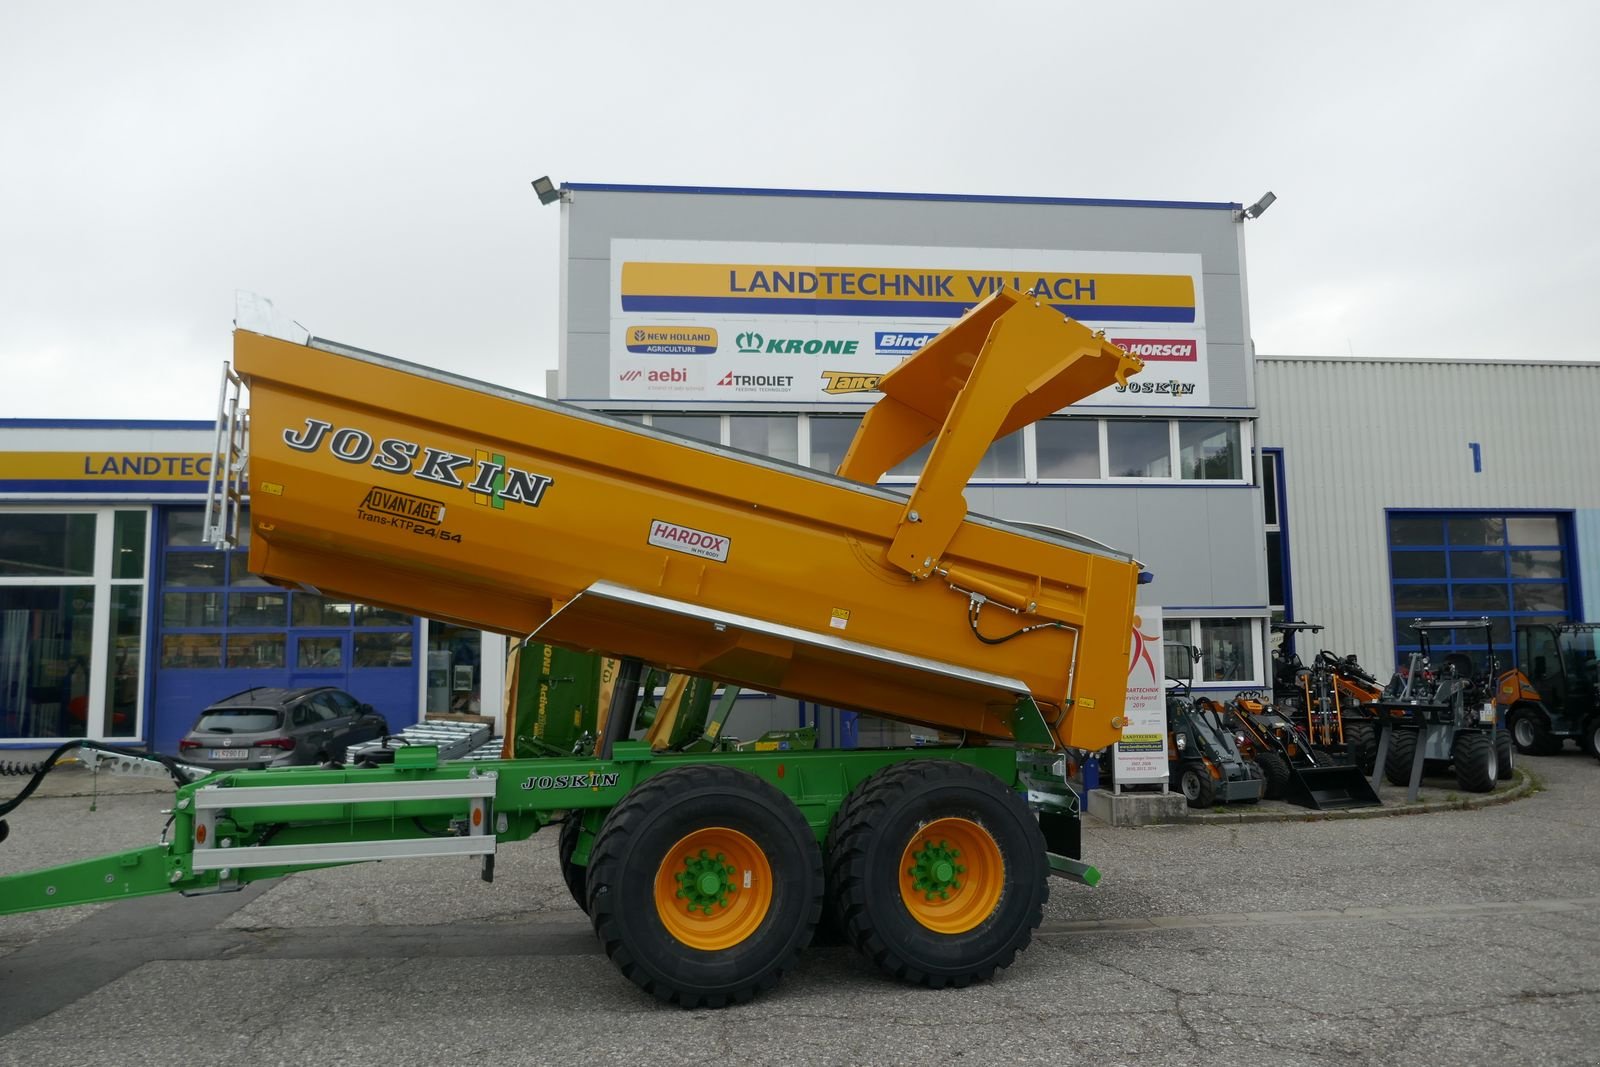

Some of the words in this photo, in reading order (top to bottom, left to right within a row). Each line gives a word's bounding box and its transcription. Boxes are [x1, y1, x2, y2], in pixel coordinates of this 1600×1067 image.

[729, 270, 954, 297] LANDTECHNIK
[647, 333, 668, 341] NEW
[669, 333, 711, 342] HOLLAND
[646, 345, 697, 353] AGRICULTURE
[766, 339, 860, 355] KRONE
[1129, 344, 1192, 356] HORSCH
[647, 367, 688, 382] aebi
[733, 375, 794, 386] TRIOLIET
[282, 417, 555, 508] JOSKIN
[1468, 442, 1482, 473] 1
[359, 489, 440, 521] ADVANTAGE
[654, 524, 723, 551] HARDOX
[521, 773, 620, 790] JOSKIN
